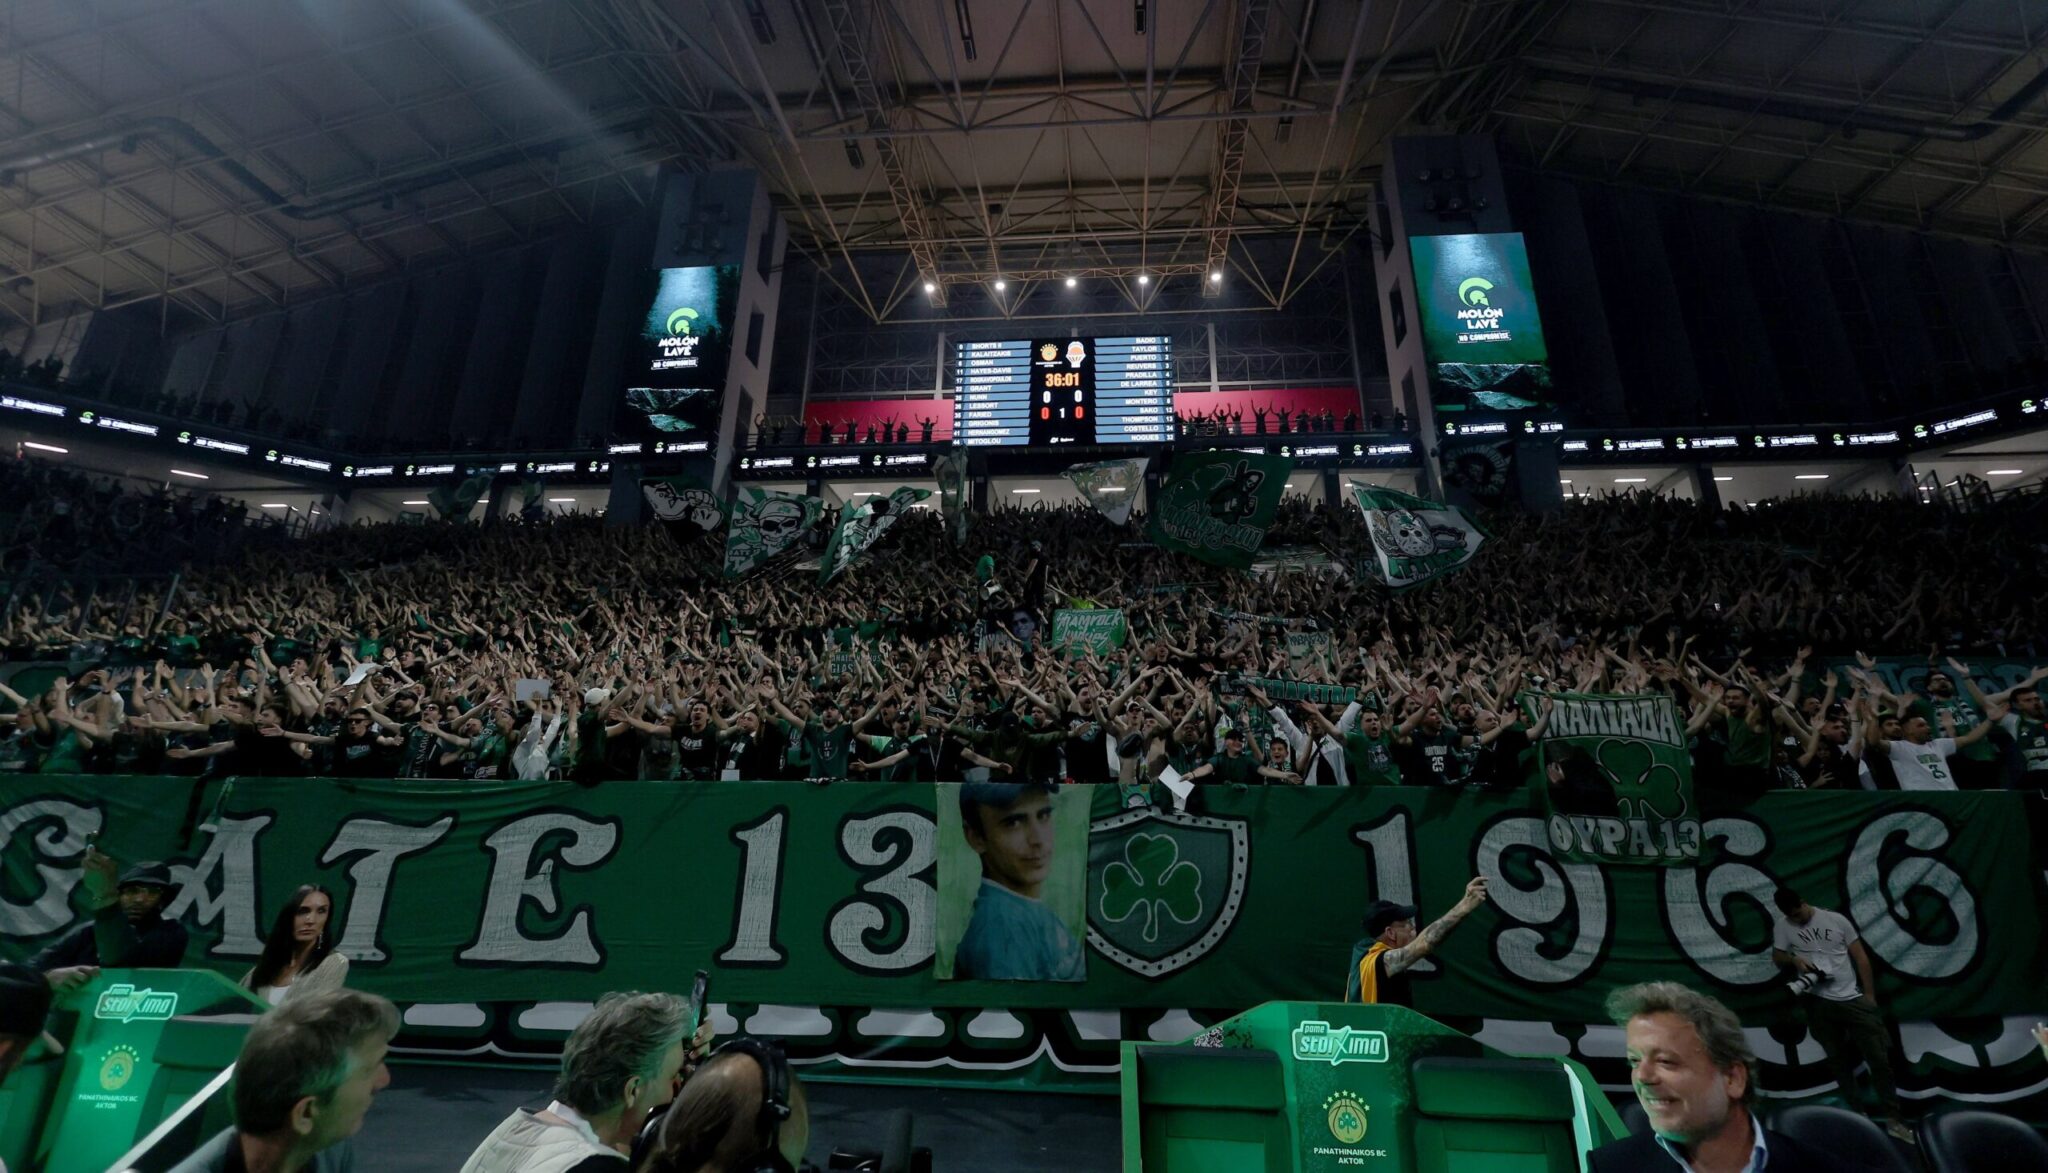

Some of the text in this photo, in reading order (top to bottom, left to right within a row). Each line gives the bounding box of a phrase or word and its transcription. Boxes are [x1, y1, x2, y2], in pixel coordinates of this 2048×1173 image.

[1457, 307, 1503, 320] MOLÓN
[1467, 317, 1500, 329] LAVÉ
[658, 336, 699, 347] MOLÓN
[1458, 332, 1510, 342] NO COMPROMISE
[664, 344, 692, 357] LAVÉ
[1045, 372, 1079, 387] 36:01
[1043, 389, 1082, 403] 0 0
[1041, 406, 1084, 420] 0 1 0
[0, 799, 1980, 984] GATE 13 1966
[1798, 927, 1833, 944] NIKE
[1304, 1025, 1325, 1034] pame
[1313, 1147, 1375, 1157] PANATHINAIKOS
[1338, 1157, 1364, 1165] AKTOR
